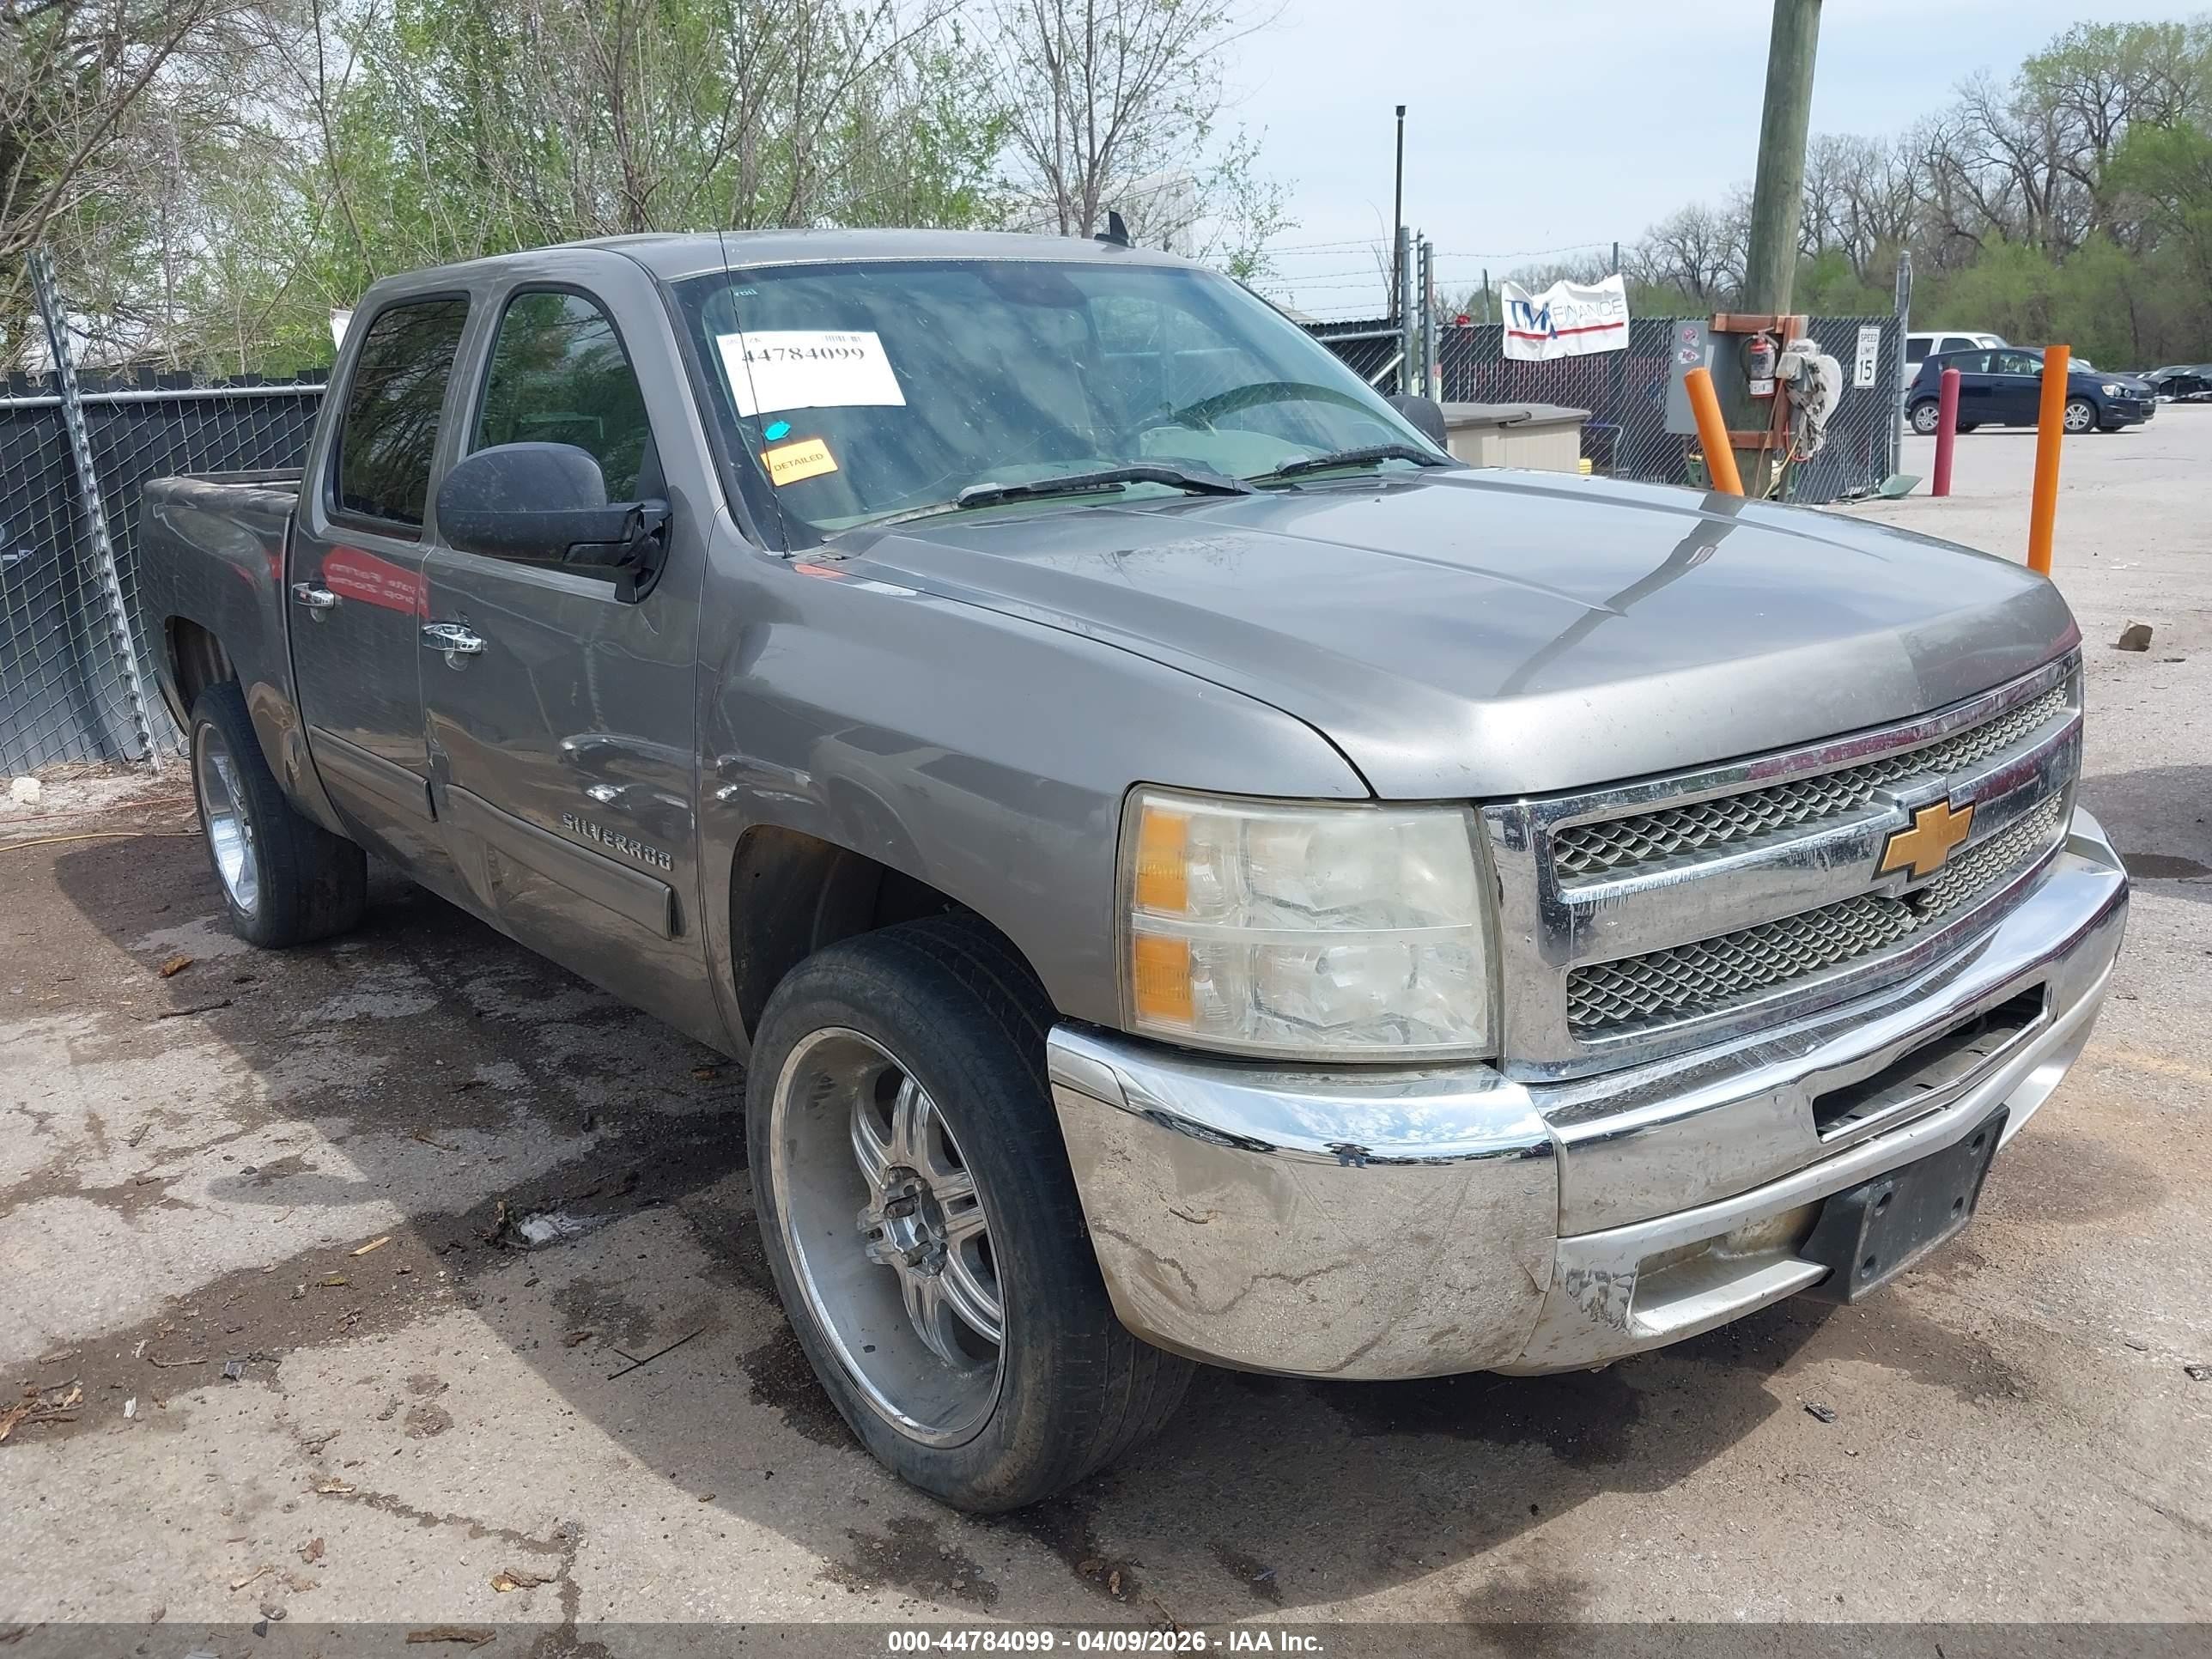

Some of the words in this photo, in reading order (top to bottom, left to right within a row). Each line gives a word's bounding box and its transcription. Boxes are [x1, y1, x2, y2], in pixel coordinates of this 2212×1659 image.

[1553, 298, 1625, 325] FINANCE
[1860, 333, 1877, 343] SPEED
[742, 347, 865, 363] 44784099
[1859, 360, 1873, 380] 15
[774, 453, 823, 471] DETAILED
[562, 812, 673, 872] SILVERADO
